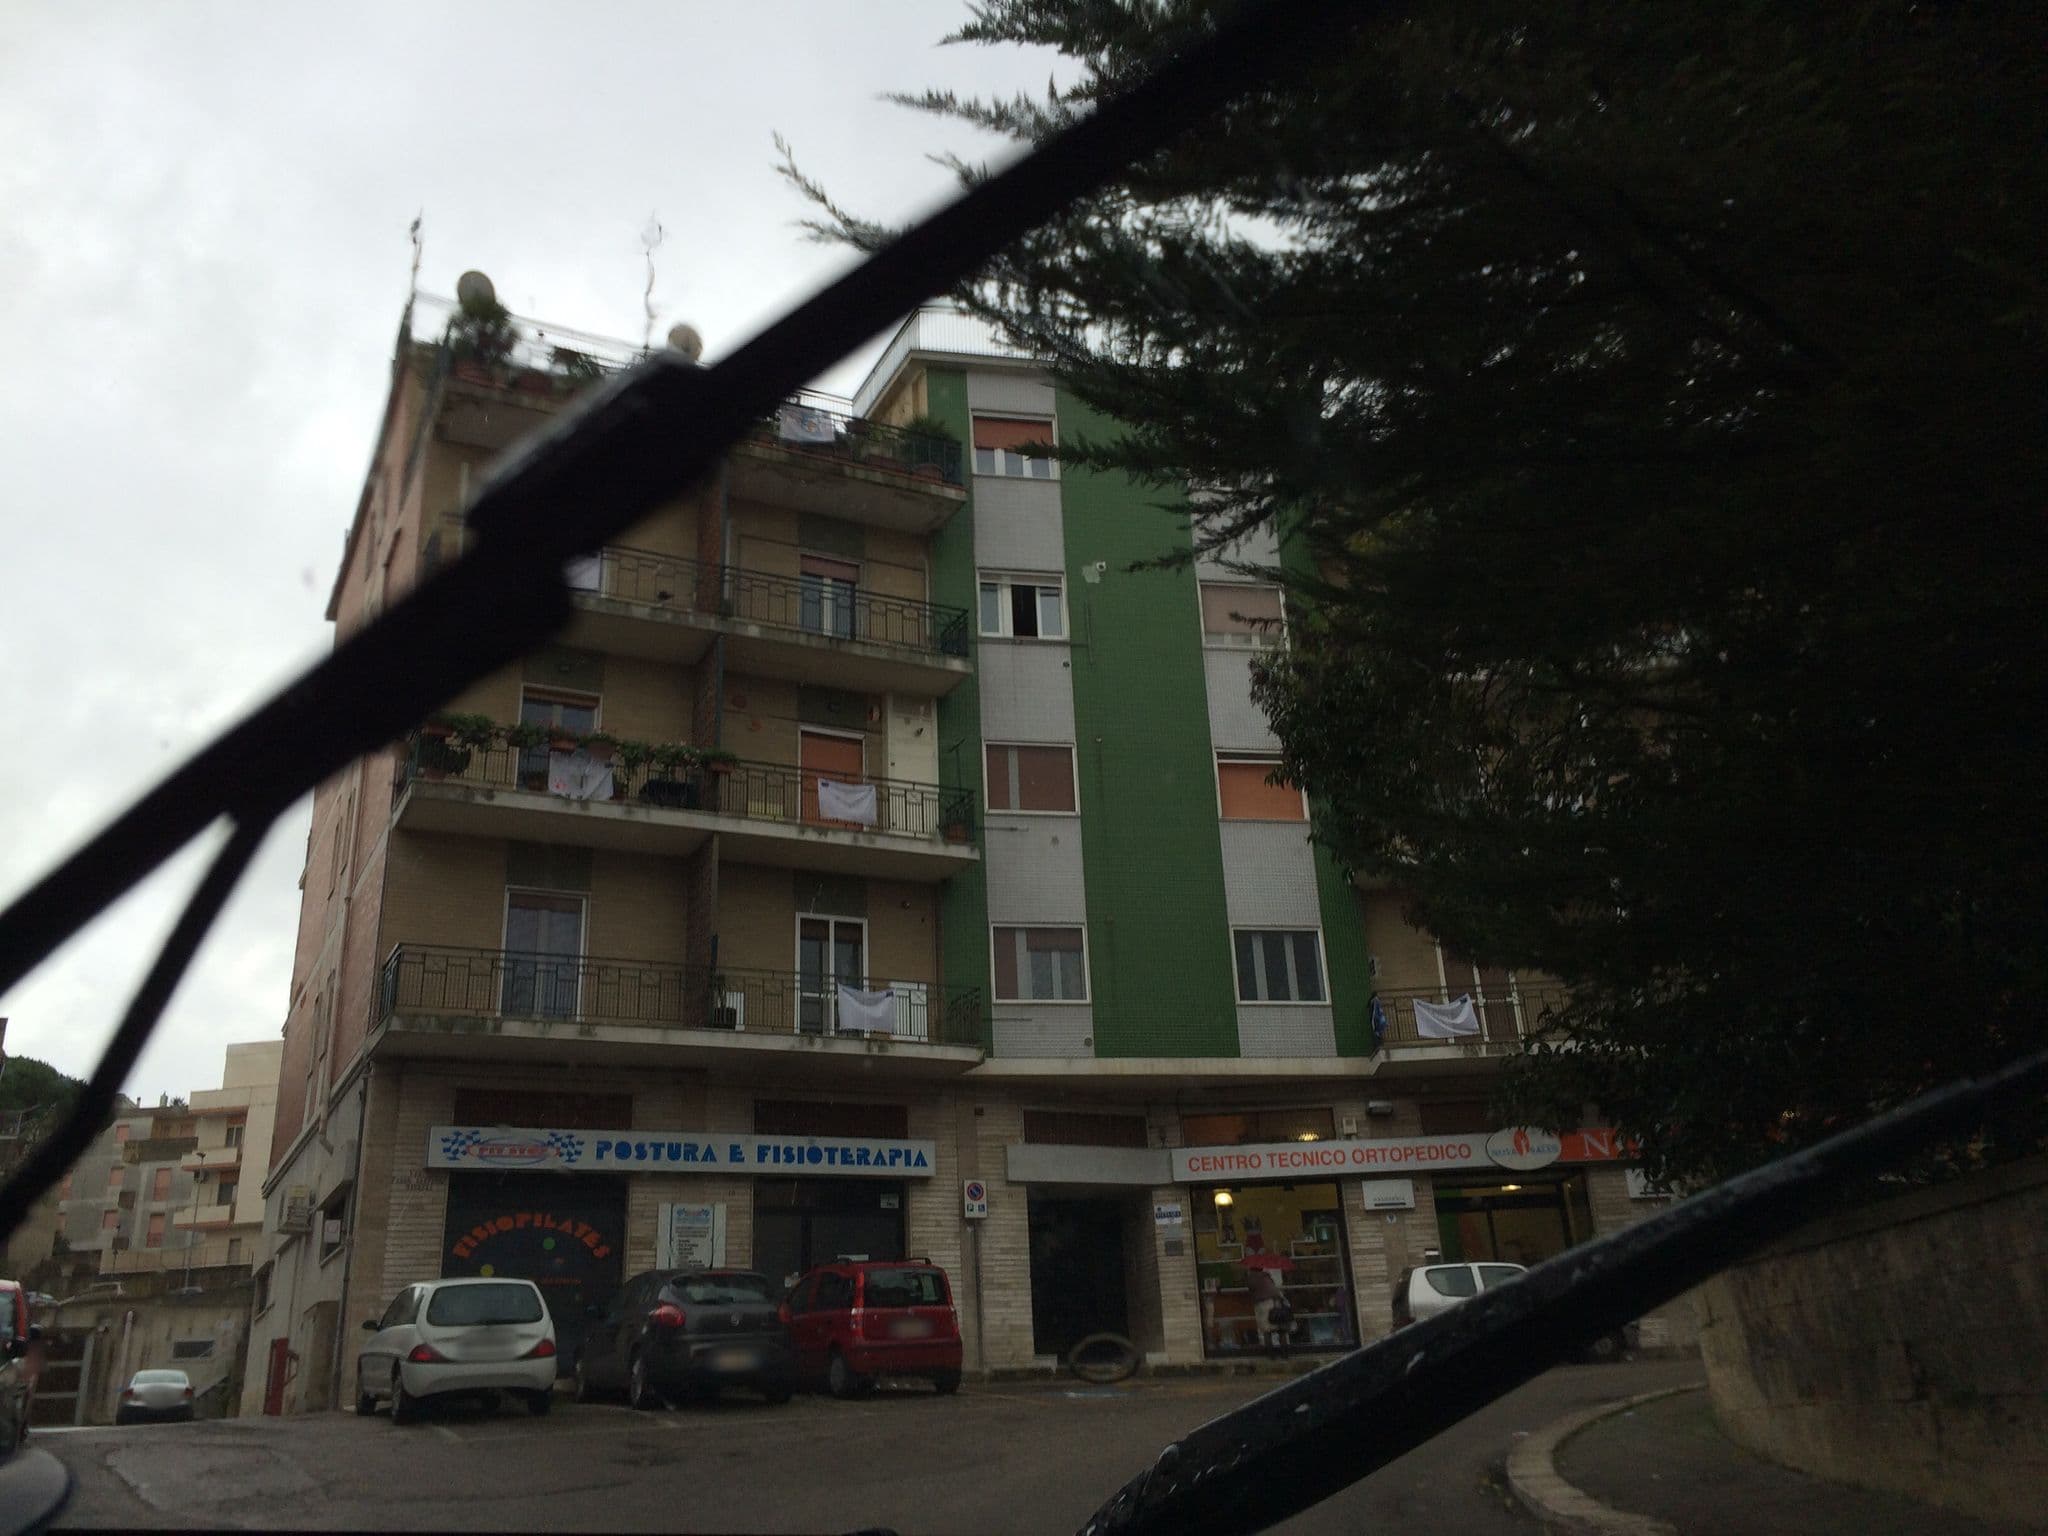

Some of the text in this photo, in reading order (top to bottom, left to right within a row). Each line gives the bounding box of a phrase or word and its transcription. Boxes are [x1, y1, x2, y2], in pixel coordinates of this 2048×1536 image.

[596, 1141, 927, 1167] POSTURA E FISIOTERAPIA
[1188, 1143, 1472, 1173] CENTRO TECNICO ORTOPEDICO
[452, 1212, 612, 1259] FISIOPILATES
